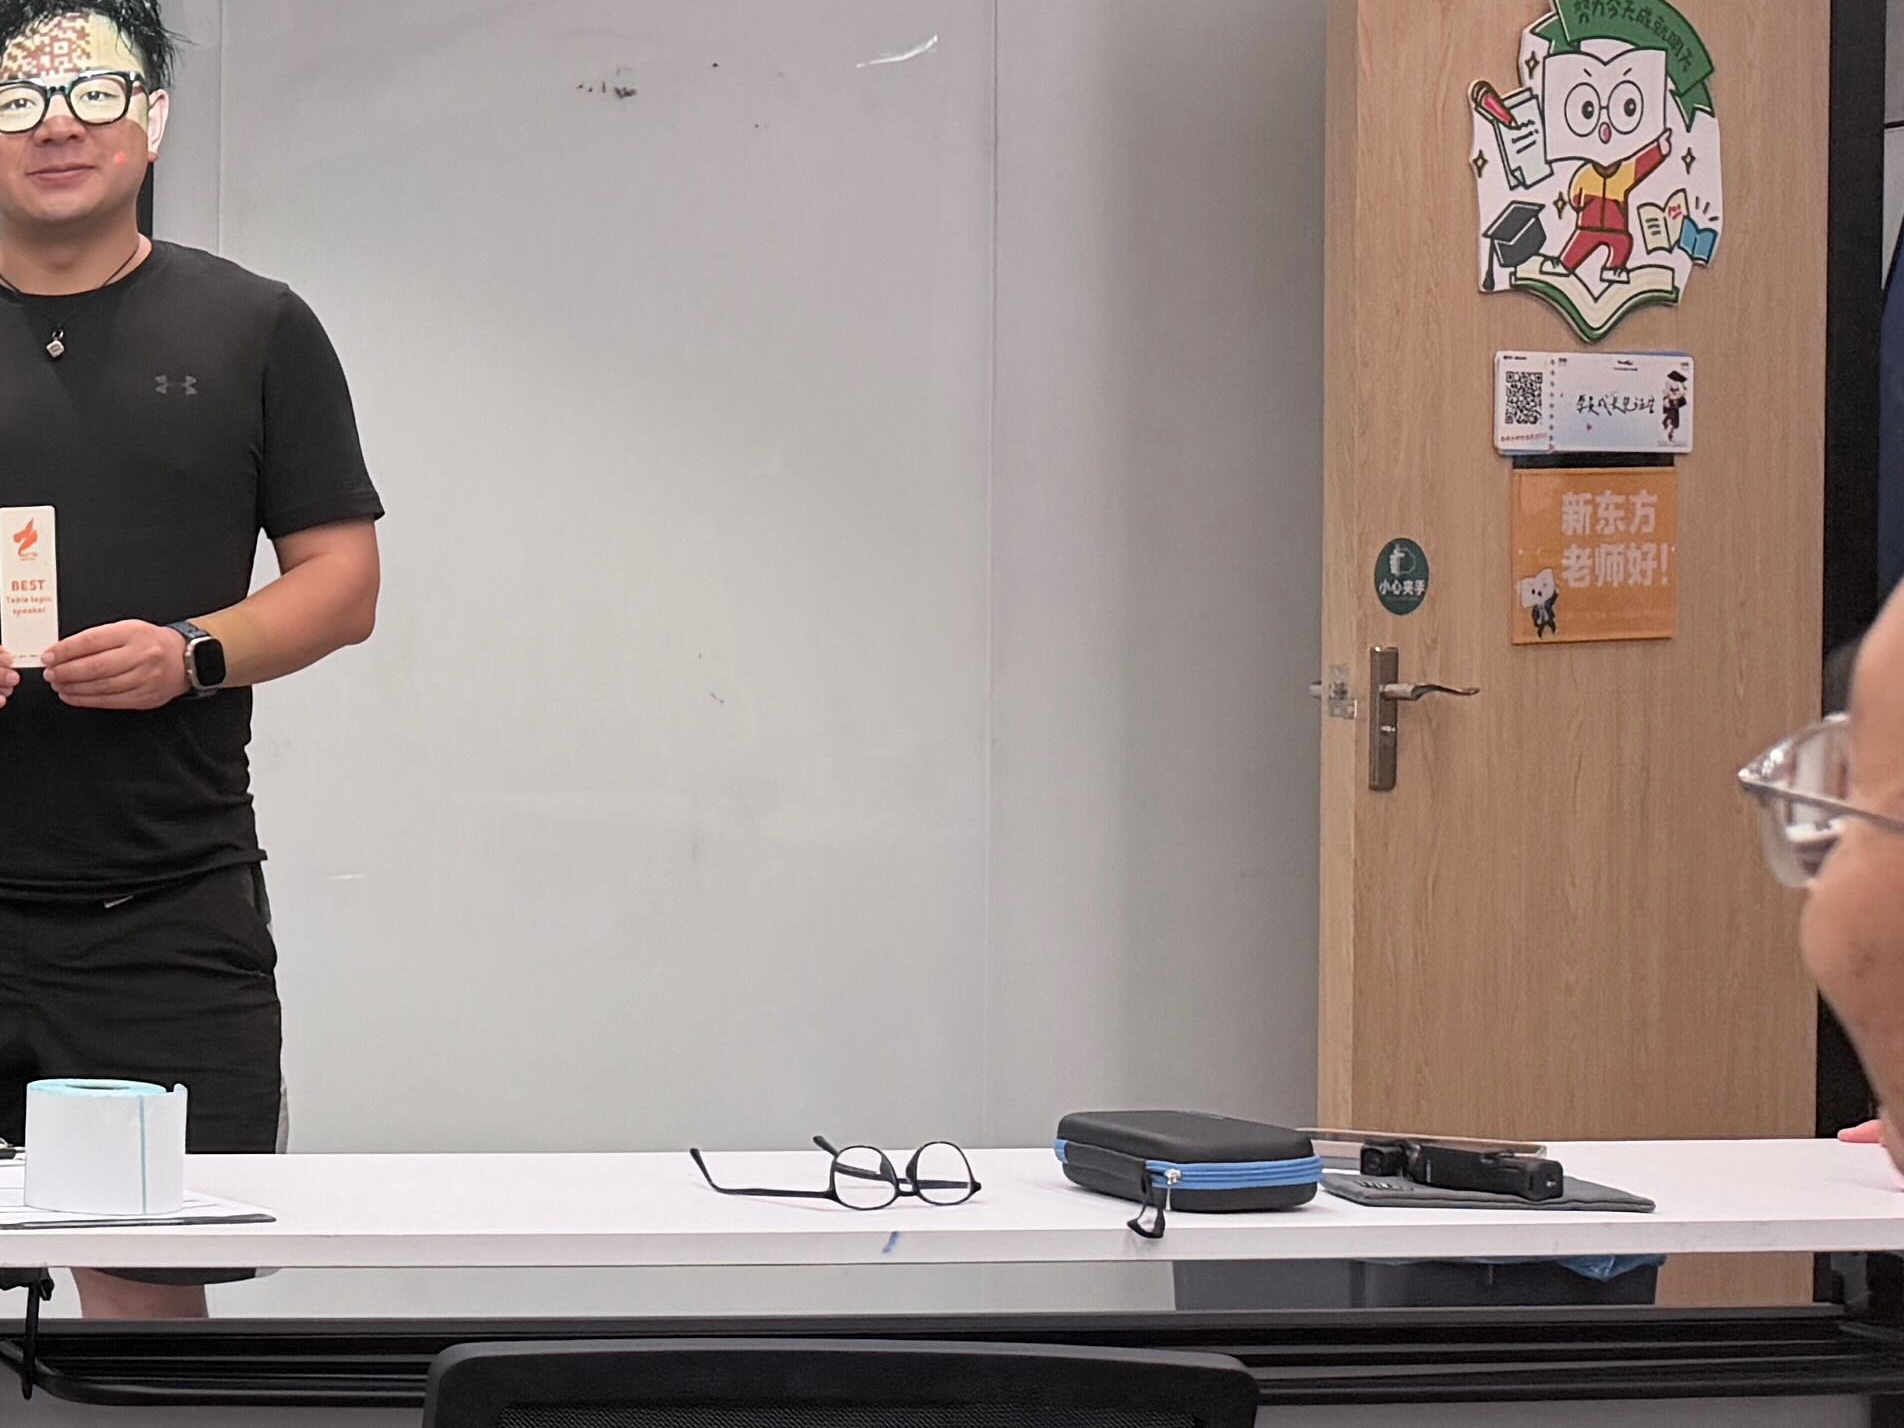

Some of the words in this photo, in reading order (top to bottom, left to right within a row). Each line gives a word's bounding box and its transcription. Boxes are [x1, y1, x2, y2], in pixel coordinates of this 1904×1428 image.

[1562, 489, 1658, 536] 新东方
[11, 580, 46, 591] BEST
[1561, 543, 1668, 589] 老师好！
